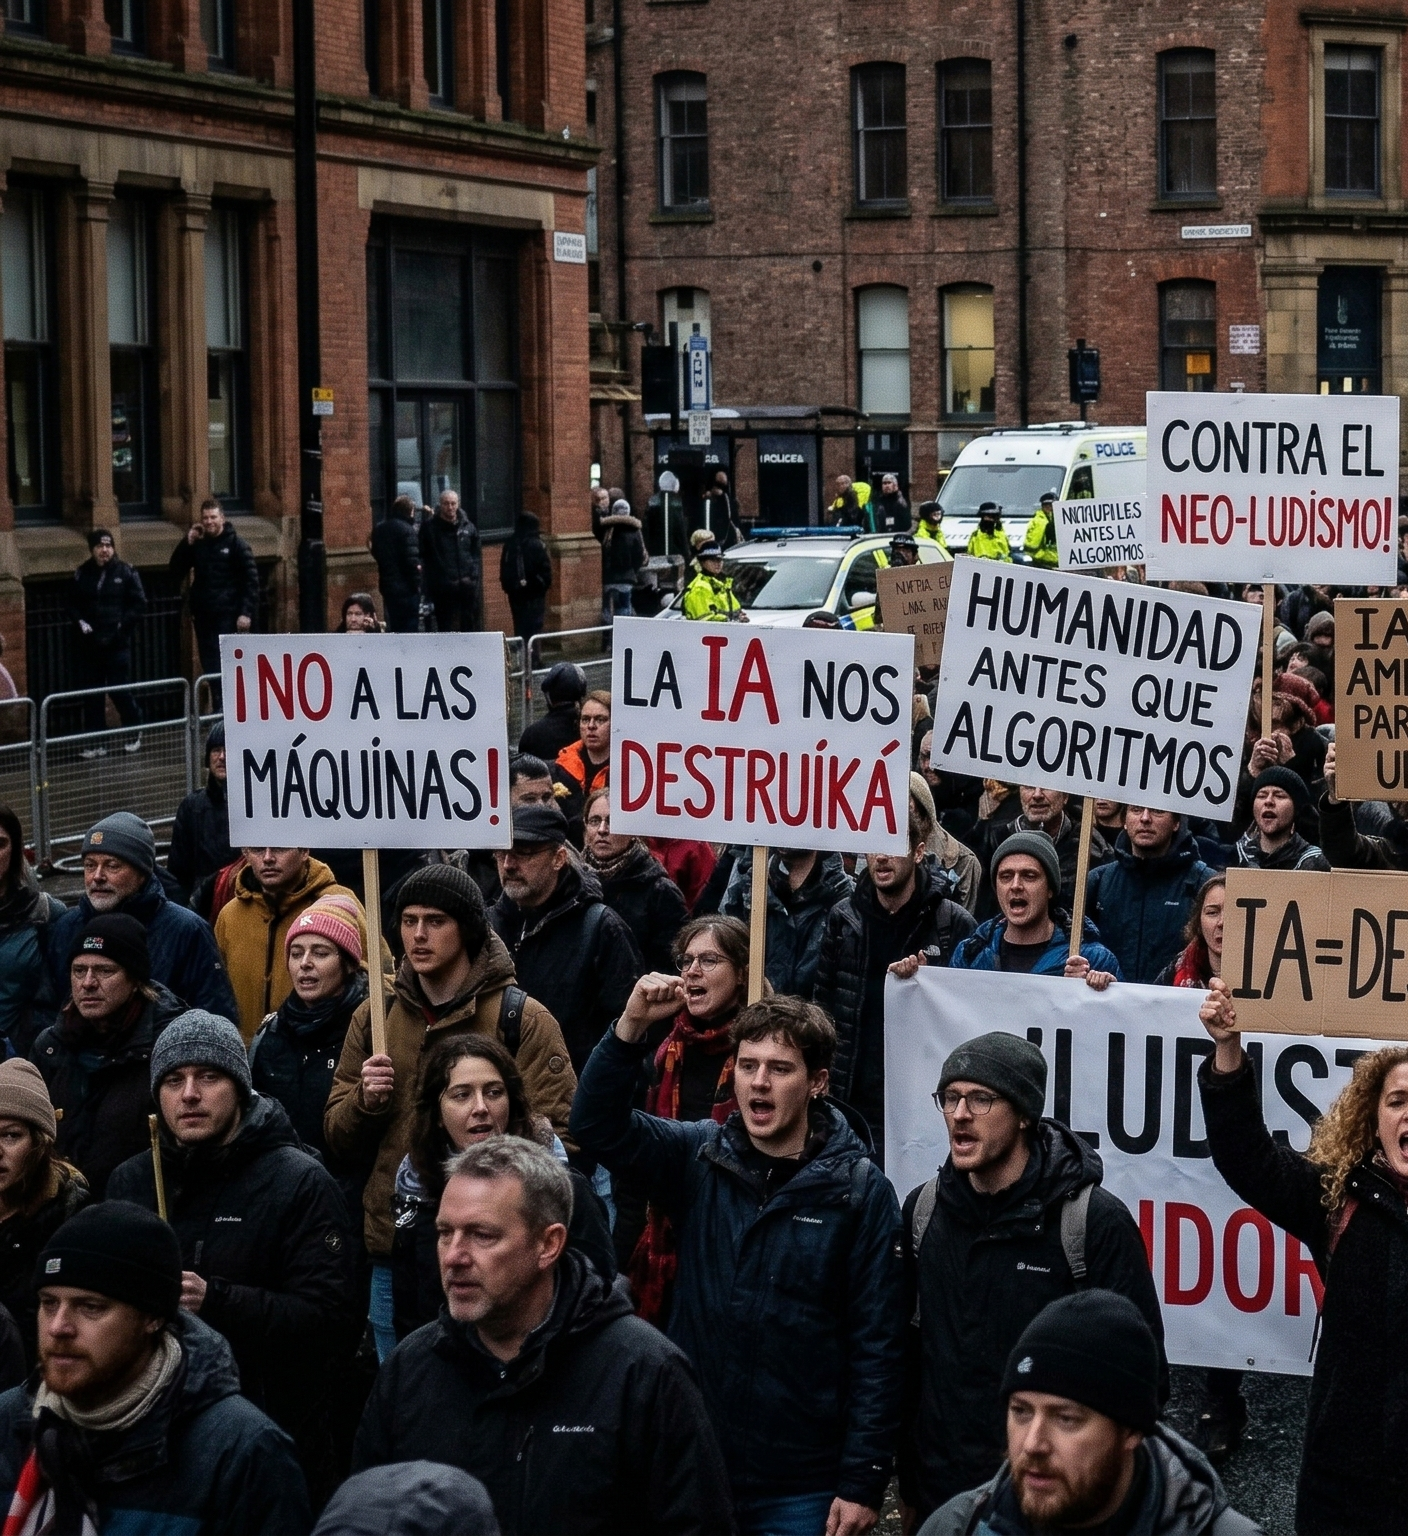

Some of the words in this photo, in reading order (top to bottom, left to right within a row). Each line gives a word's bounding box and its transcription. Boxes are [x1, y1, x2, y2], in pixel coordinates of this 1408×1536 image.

[1095, 442, 1136, 457] POLICE
[1160, 418, 1328, 476] CONTRA
[1341, 423, 1385, 478] EL
[1073, 526, 1114, 543] ANTES
[1117, 524, 1136, 540] LA
[966, 572, 1243, 671] HUMANIDAD
[234, 648, 332, 723] ¡NO
[350, 674, 379, 720] A
[395, 665, 477, 720] LAS
[623, 647, 682, 710] LA
[700, 636, 779, 724] IA
[802, 660, 900, 726] NOS
[967, 646, 1107, 708] ANTES
[1131, 673, 1218, 728] QUE
[620, 739, 900, 836] DESTRUÍKÁ
[942, 701, 1234, 805] ALGORITMOS
